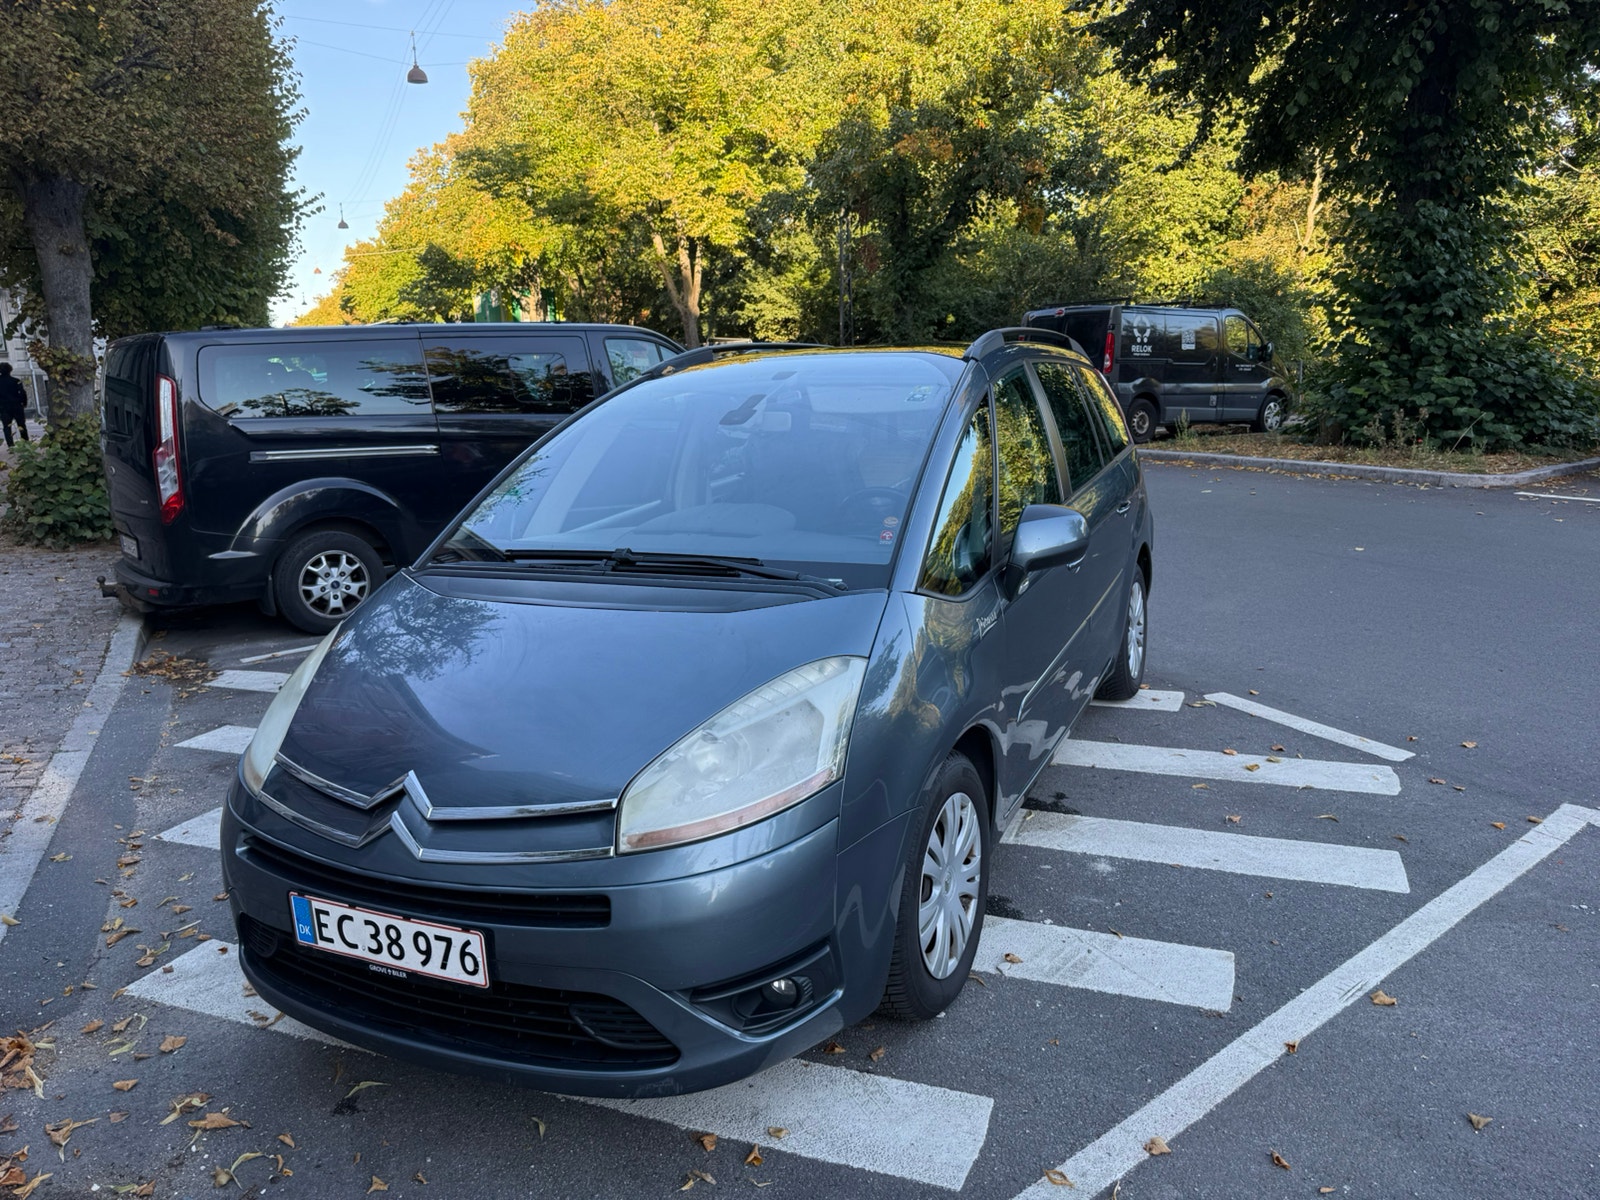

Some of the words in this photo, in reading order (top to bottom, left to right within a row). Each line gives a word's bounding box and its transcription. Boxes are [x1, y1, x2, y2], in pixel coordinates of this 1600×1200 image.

[1131, 344, 1153, 353] RELOK
[299, 923, 312, 936] DK
[314, 907, 359, 950] EC
[363, 919, 406, 961] 38
[412, 930, 480, 977] 976
